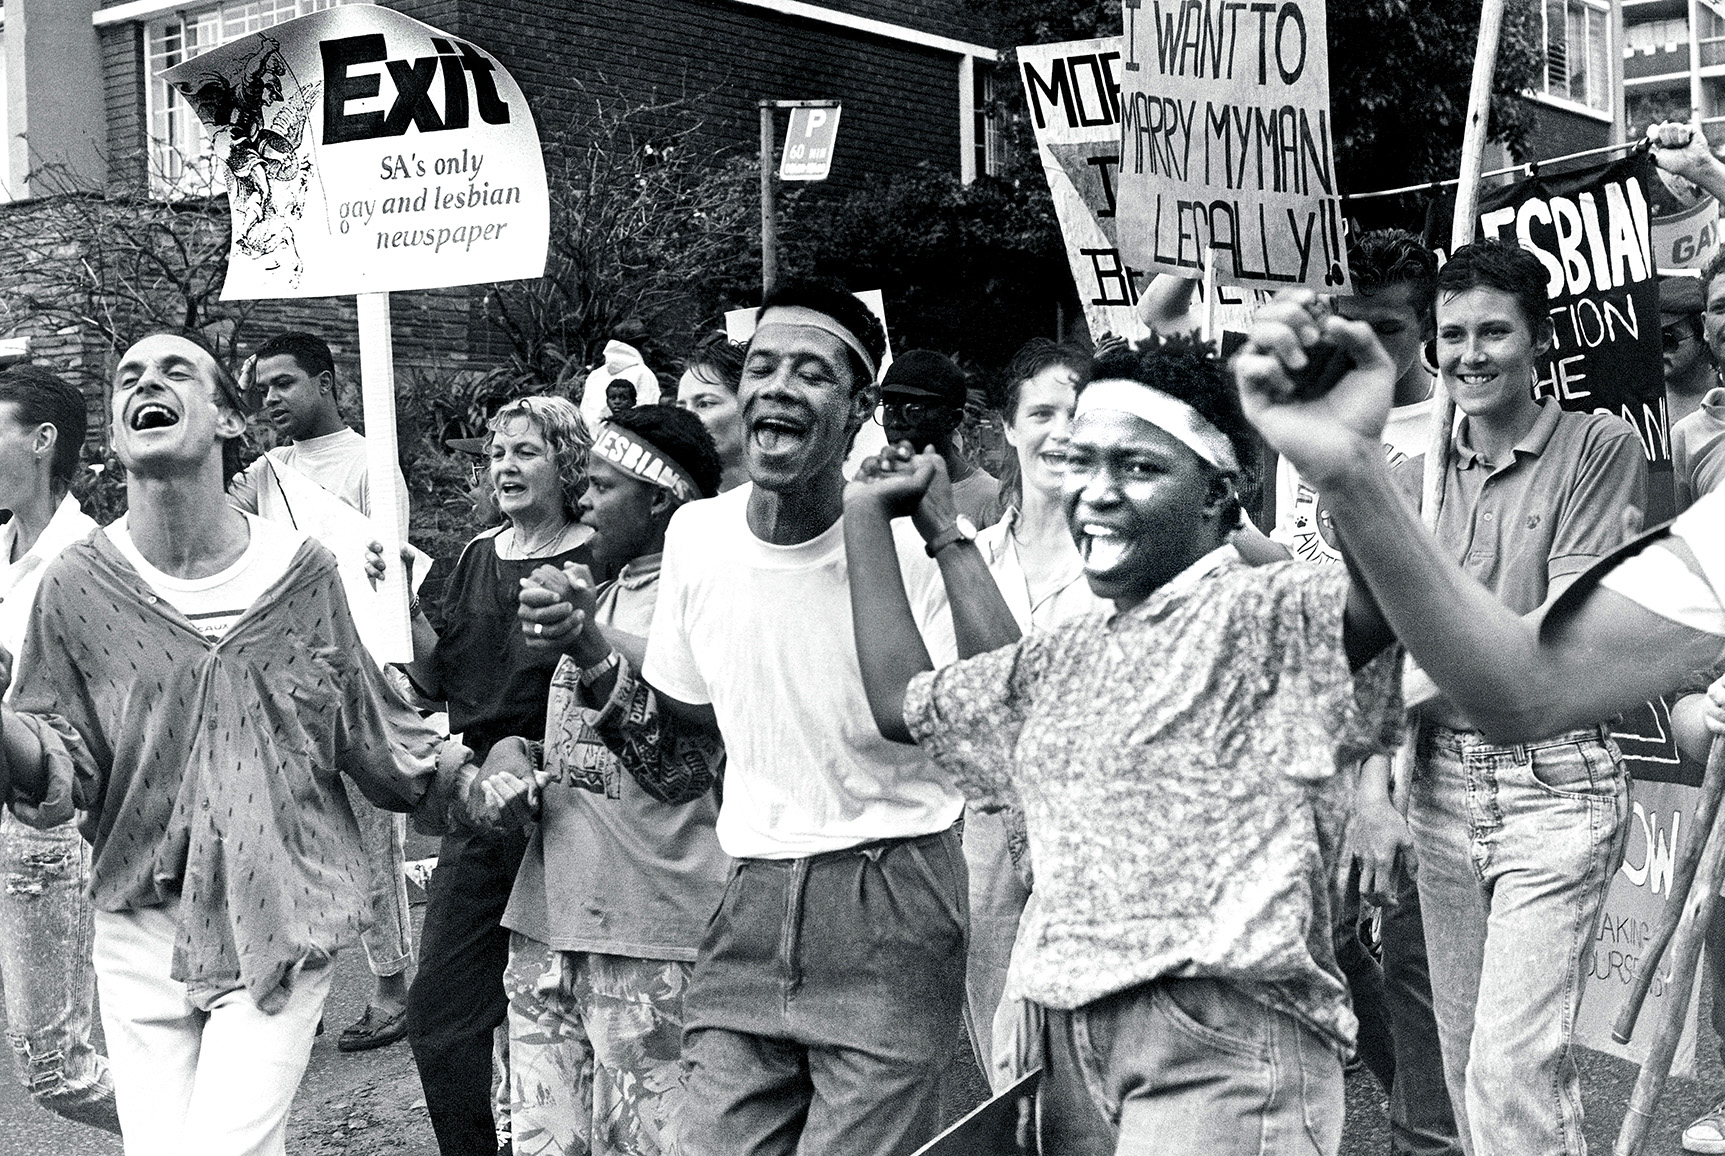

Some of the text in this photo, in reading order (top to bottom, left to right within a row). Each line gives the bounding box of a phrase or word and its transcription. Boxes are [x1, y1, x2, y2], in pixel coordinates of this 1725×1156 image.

[1125, 0, 1307, 85] I WANT TO
[319, 33, 511, 145] Exit
[805, 109, 827, 138] P
[1119, 91, 1197, 182] MARRY
[380, 148, 483, 181] SA's only
[789, 144, 805, 160] 60
[339, 181, 520, 234] gay and lesbian
[377, 222, 508, 254] newspaper
